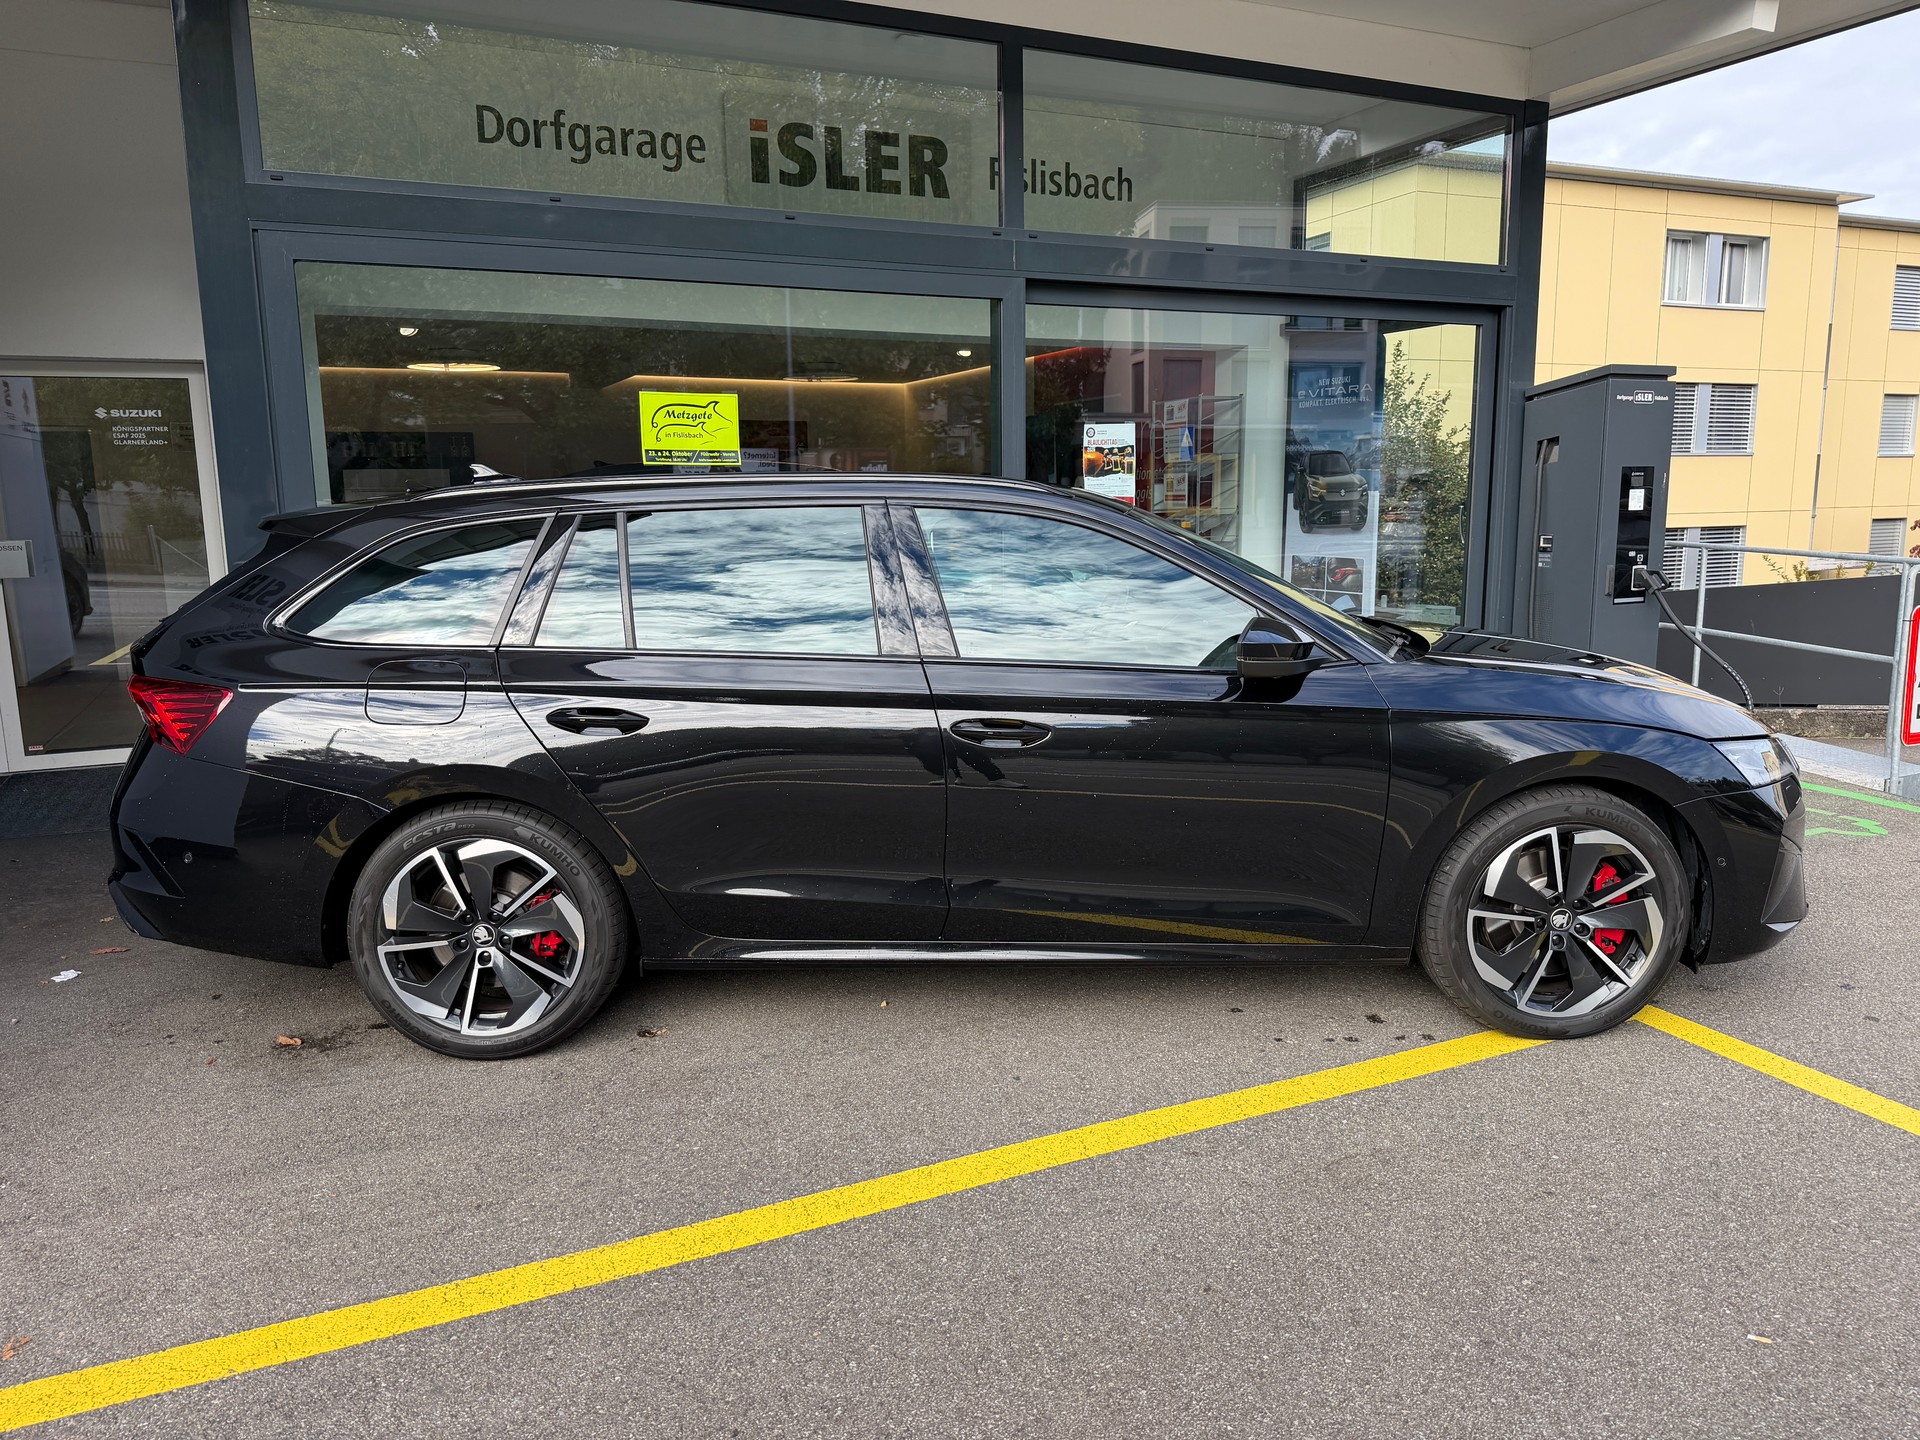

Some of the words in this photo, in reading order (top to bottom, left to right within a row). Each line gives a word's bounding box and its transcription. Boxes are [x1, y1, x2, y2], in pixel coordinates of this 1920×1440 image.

[475, 103, 707, 173] Dorfgarage
[988, 156, 1134, 203] Flisbach
[1331, 375, 1351, 385] SUZUKI
[1308, 383, 1373, 398] VITARA
[109, 409, 162, 418] SUZUKI
[663, 409, 713, 422] Metzgete
[112, 424, 169, 432] KÖNIGSPARTNER
[673, 431, 704, 440] Fislisbach
[1585, 806, 1641, 834] KUMHO
[529, 832, 581, 877] KUMHO
